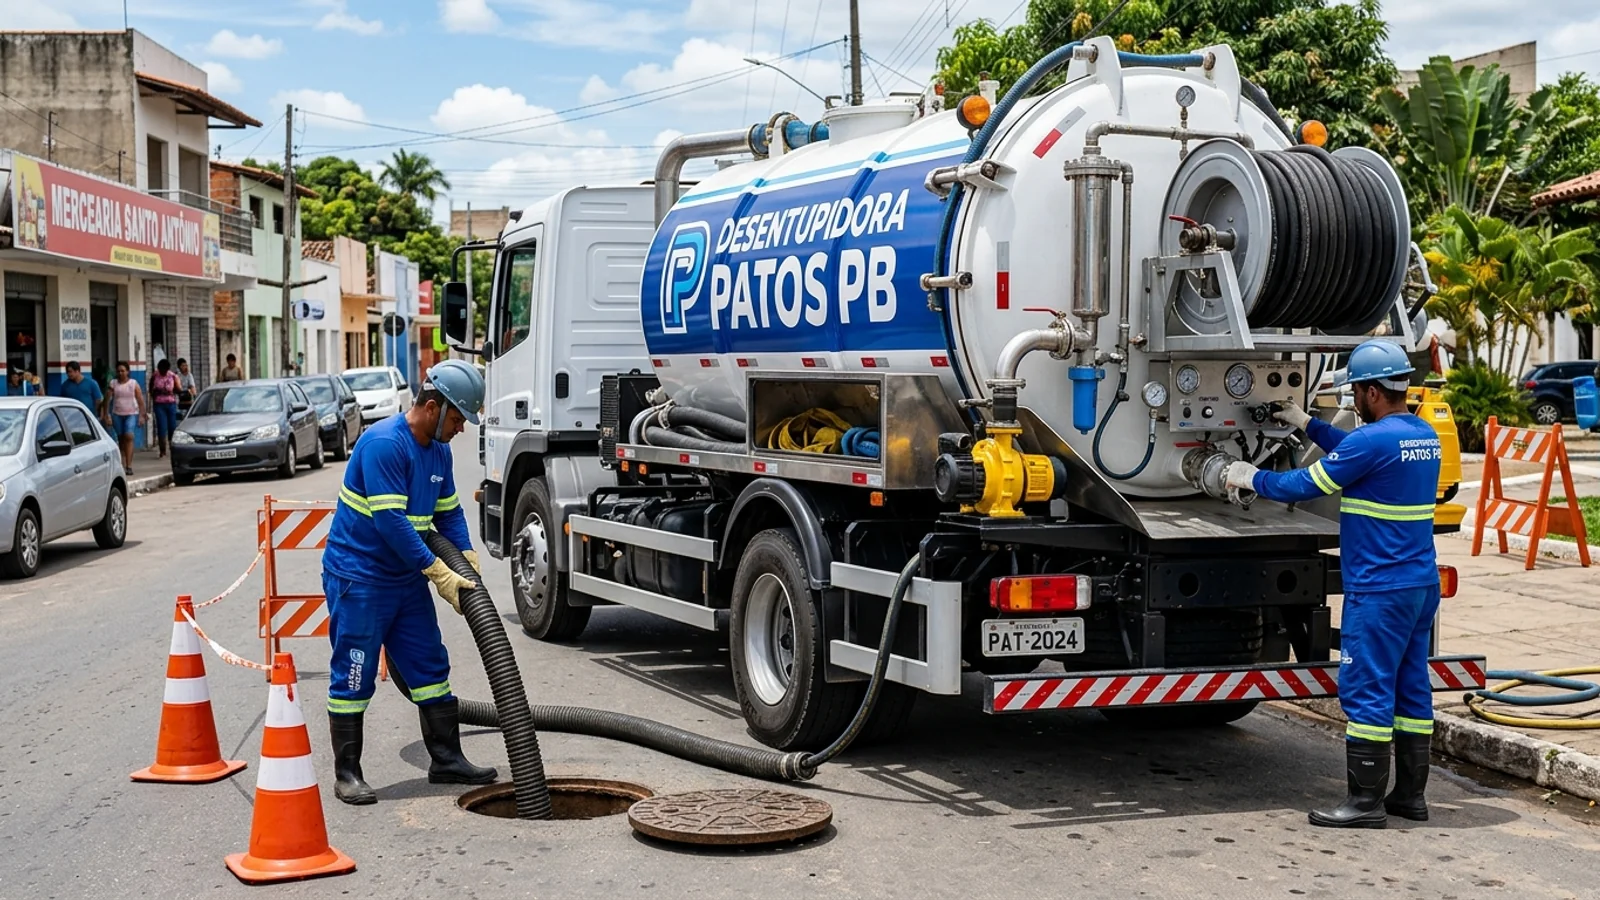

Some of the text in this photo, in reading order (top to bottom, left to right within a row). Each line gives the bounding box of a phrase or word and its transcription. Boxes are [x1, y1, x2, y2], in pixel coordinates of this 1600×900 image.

[51, 183, 122, 240] MERCEARIA
[124, 203, 159, 248] SANTO
[715, 188, 910, 255] DESENTUPIDORA
[710, 245, 898, 331] PATOS PB
[1401, 448, 1431, 462] PATOS
